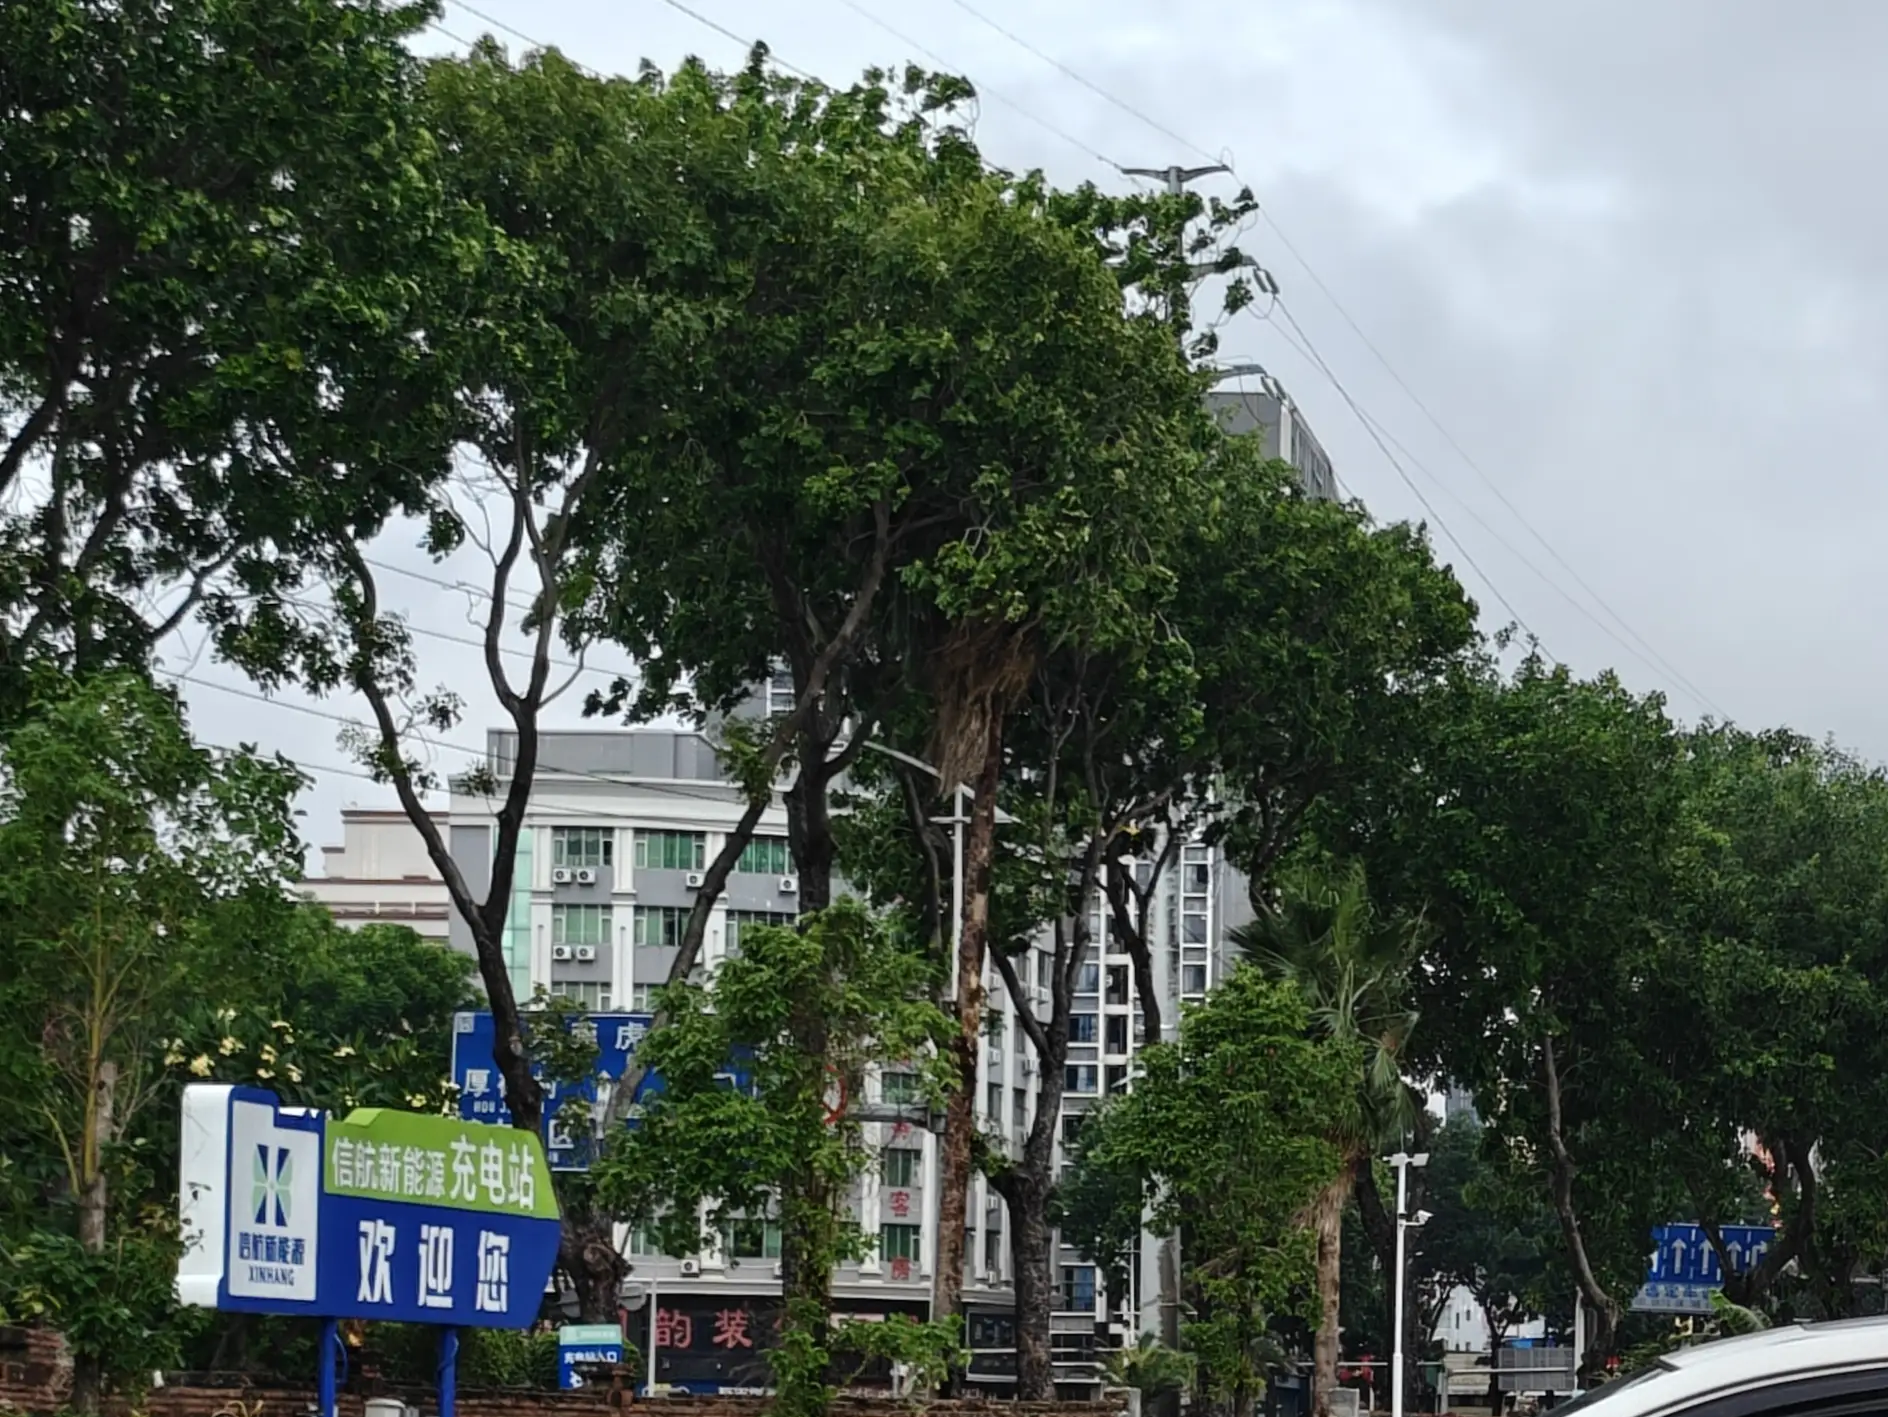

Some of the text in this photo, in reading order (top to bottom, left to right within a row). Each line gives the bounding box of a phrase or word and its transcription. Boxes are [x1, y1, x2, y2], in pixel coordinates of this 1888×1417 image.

[332, 1134, 536, 1210] 信航新能源充电站
[248, 1265, 295, 1287] XINHANG
[357, 1218, 511, 1313] 欢迎您
